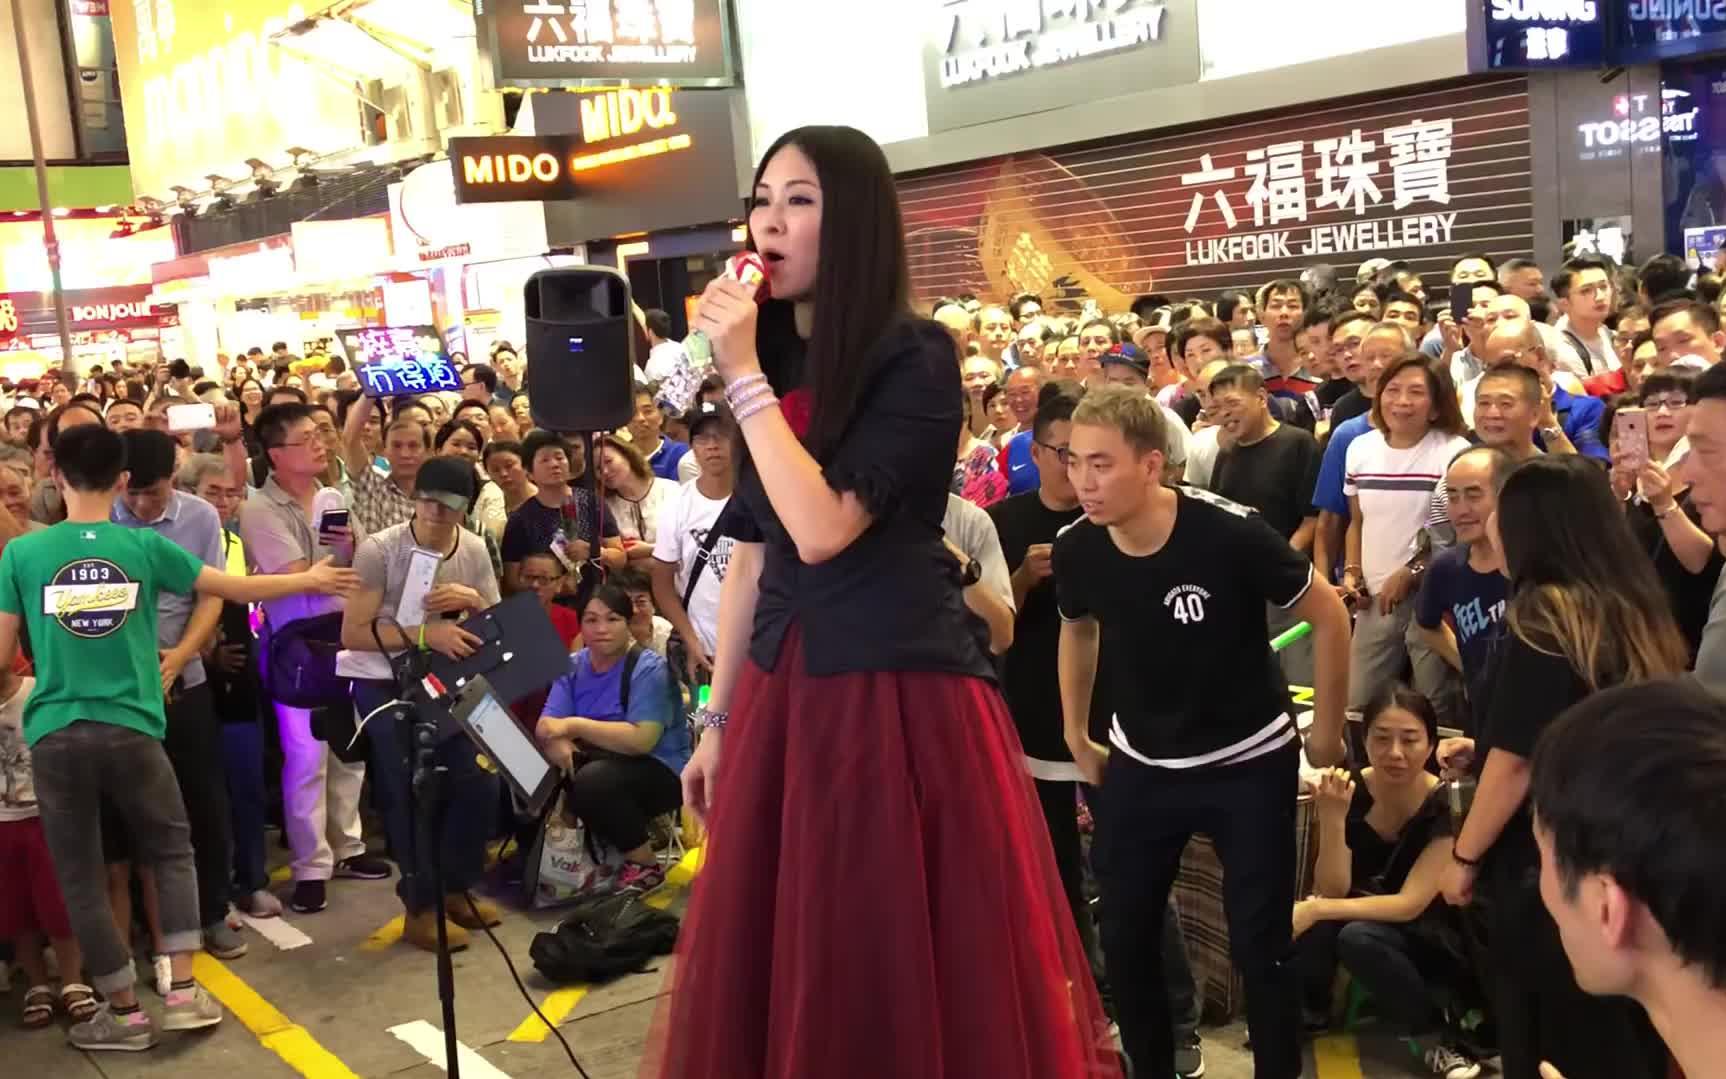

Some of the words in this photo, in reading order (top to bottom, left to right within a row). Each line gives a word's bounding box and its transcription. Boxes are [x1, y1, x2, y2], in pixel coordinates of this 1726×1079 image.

[528, 45, 605, 63] LUKFOOK
[463, 153, 560, 184] MIDO
[1181, 118, 1453, 234] 六福珠寶
[1185, 231, 1292, 266] LUKFOOK
[1302, 213, 1457, 255] JEWELLERY
[71, 567, 110, 581] 1903
[50, 582, 129, 618] Yankees
[1173, 593, 1205, 624] 40
[71, 618, 90, 628] NEW
[92, 618, 113, 627] YORK
